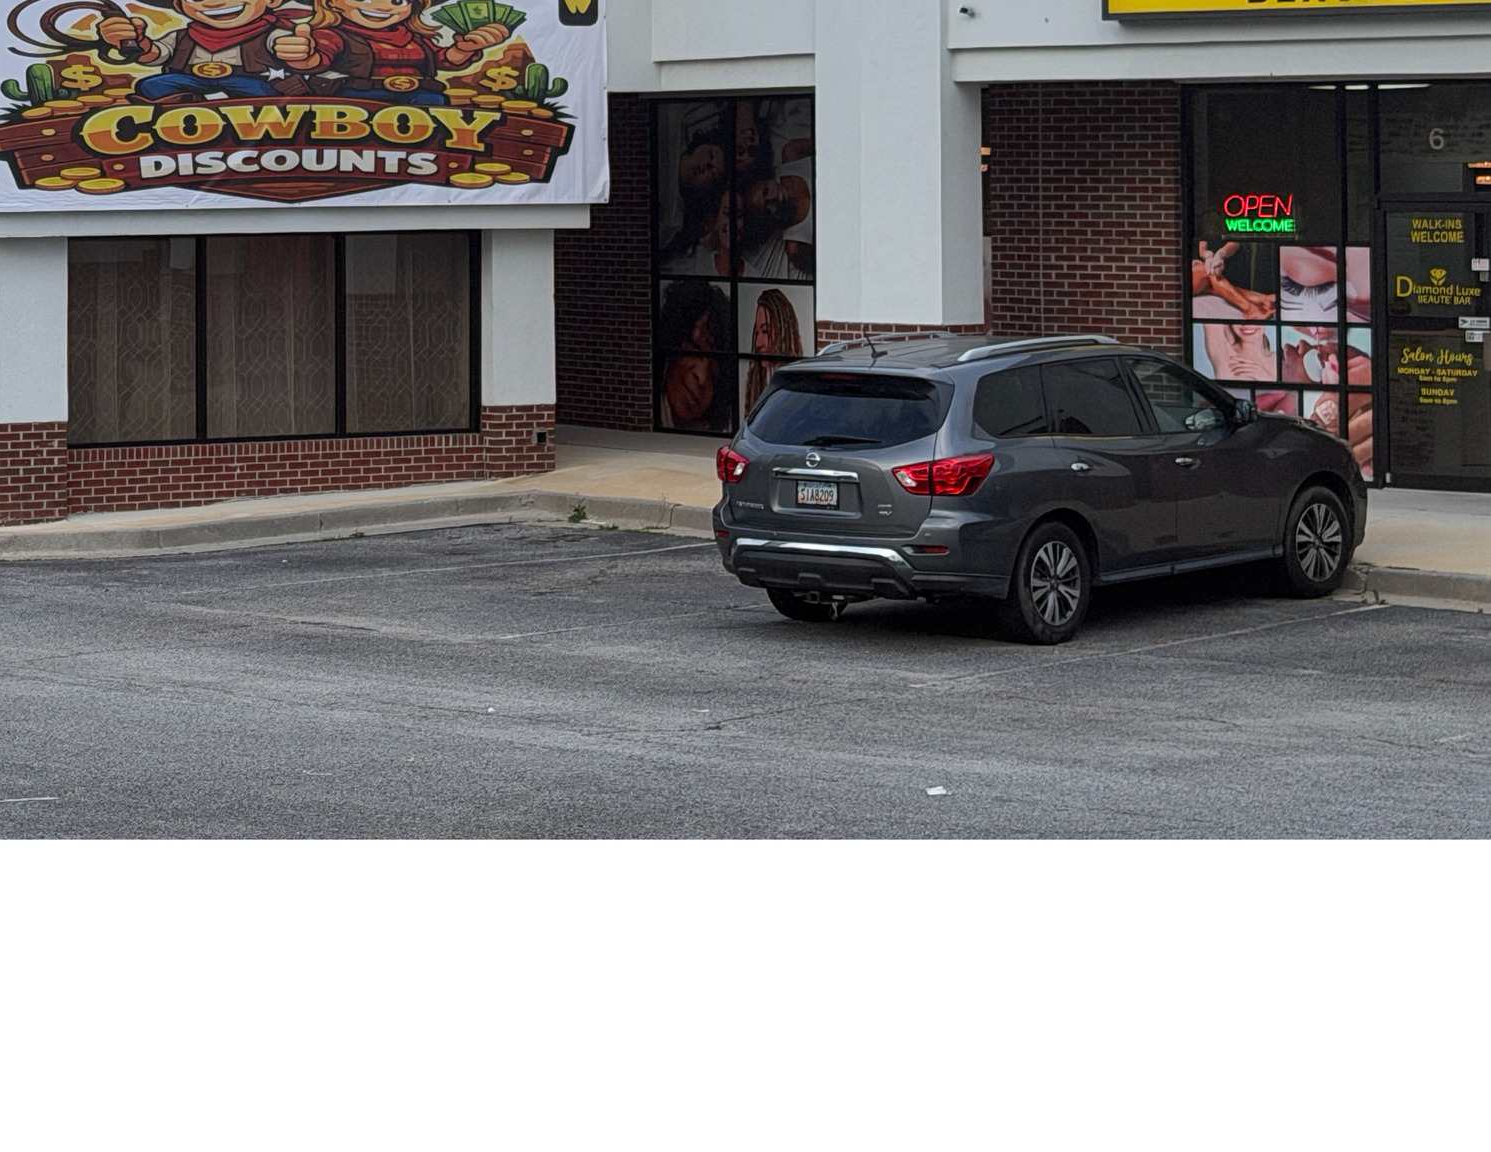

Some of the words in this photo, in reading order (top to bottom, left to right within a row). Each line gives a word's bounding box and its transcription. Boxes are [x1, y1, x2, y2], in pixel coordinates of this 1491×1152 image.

[79, 104, 501, 153] COWBOY
[1429, 128, 1445, 150] 6
[140, 149, 438, 179] DISCOUNTS
[1223, 193, 1293, 217] OPEN
[1225, 219, 1295, 232] WELCOME
[1412, 218, 1462, 229] WALK-INS
[1411, 231, 1464, 243] WELCOME
[1456, 284, 1481, 297] Luxe
[1453, 297, 1471, 305] BAR
[1401, 347, 1434, 364] Salon
[1436, 349, 1473, 366] Hours
[1397, 367, 1430, 375] MONDAY
[1436, 368, 1478, 377] SATURDAY
[1420, 388, 1455, 397] SUNDAY
